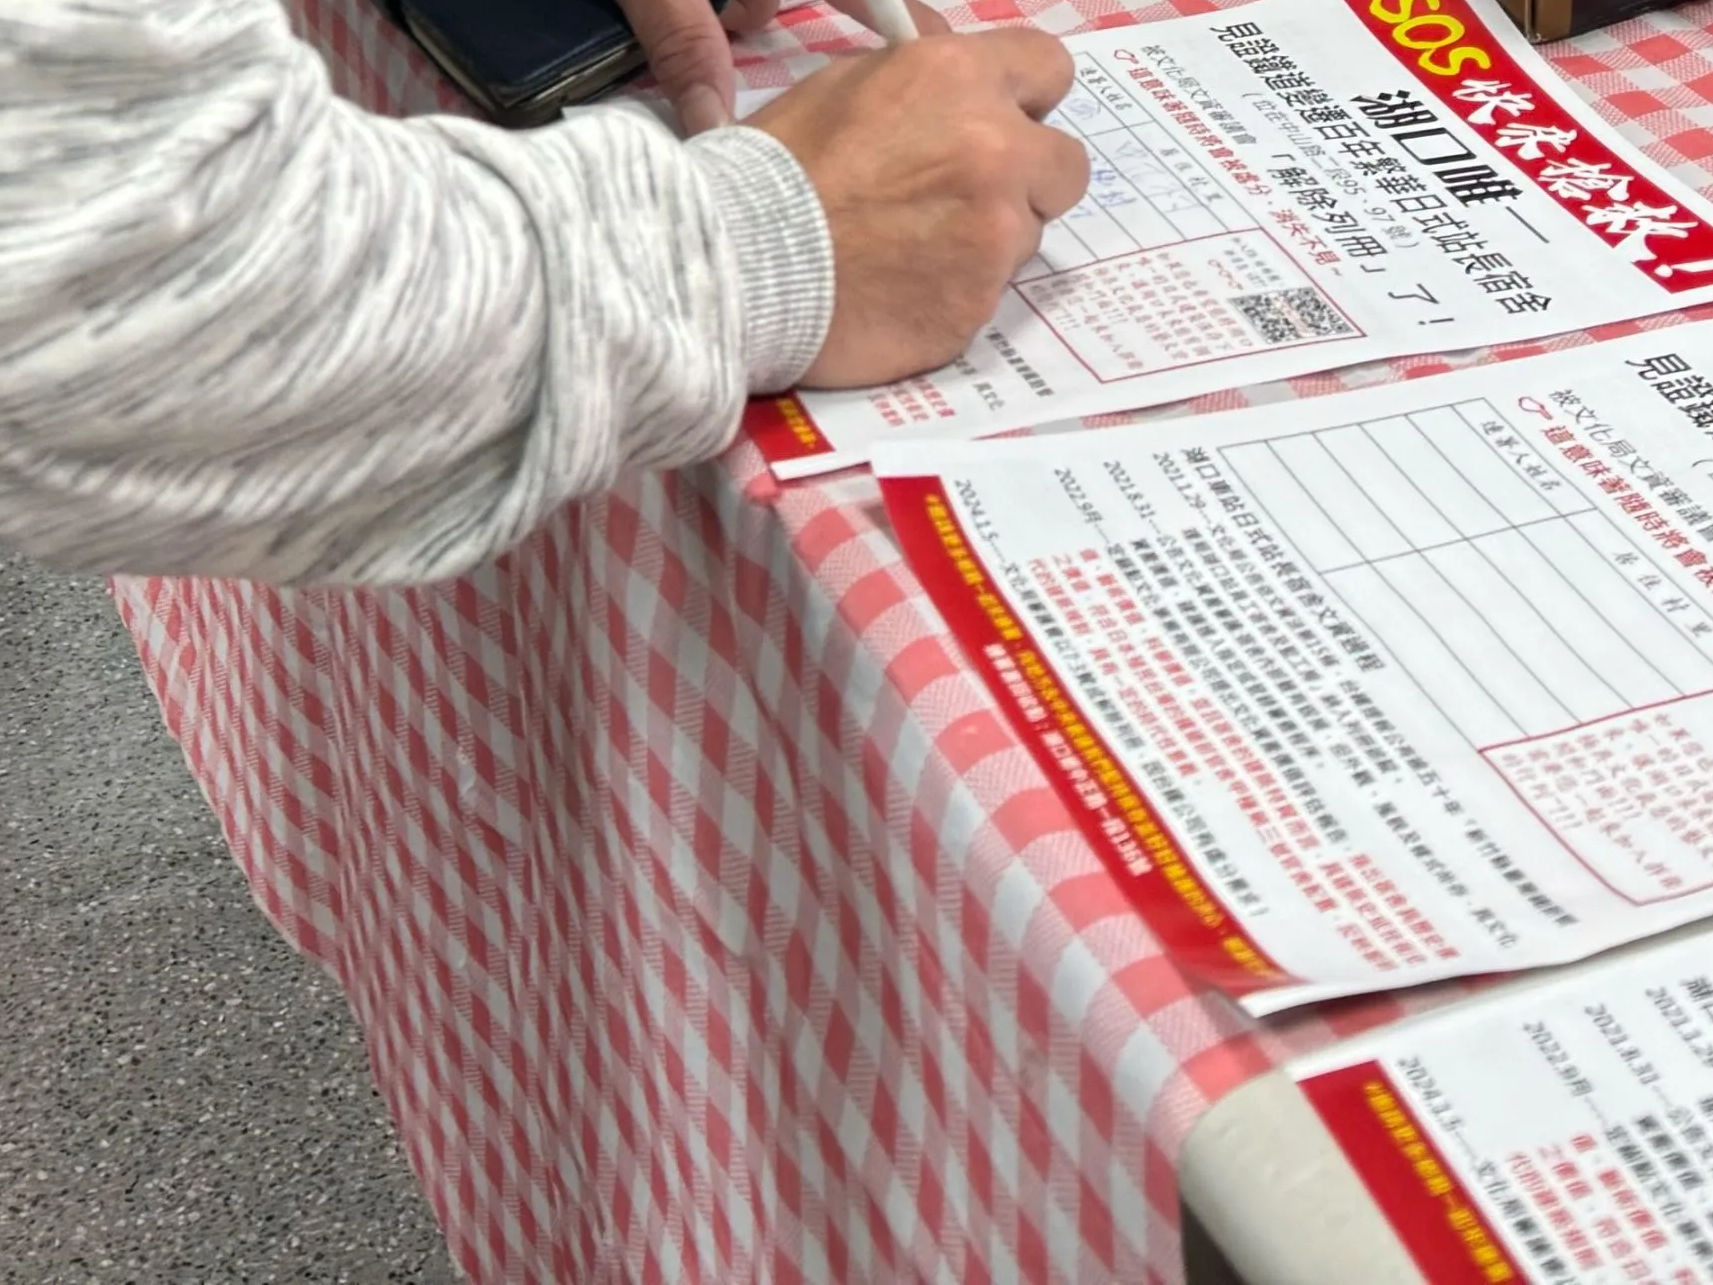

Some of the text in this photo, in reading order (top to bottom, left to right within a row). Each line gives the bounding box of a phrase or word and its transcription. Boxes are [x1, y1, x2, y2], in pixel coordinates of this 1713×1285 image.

[1137, 44, 1262, 145] 被文化局文資審議會
[1253, 153, 1394, 275] 「解除列冊」
[1347, 89, 1553, 243] 湖口唯一
